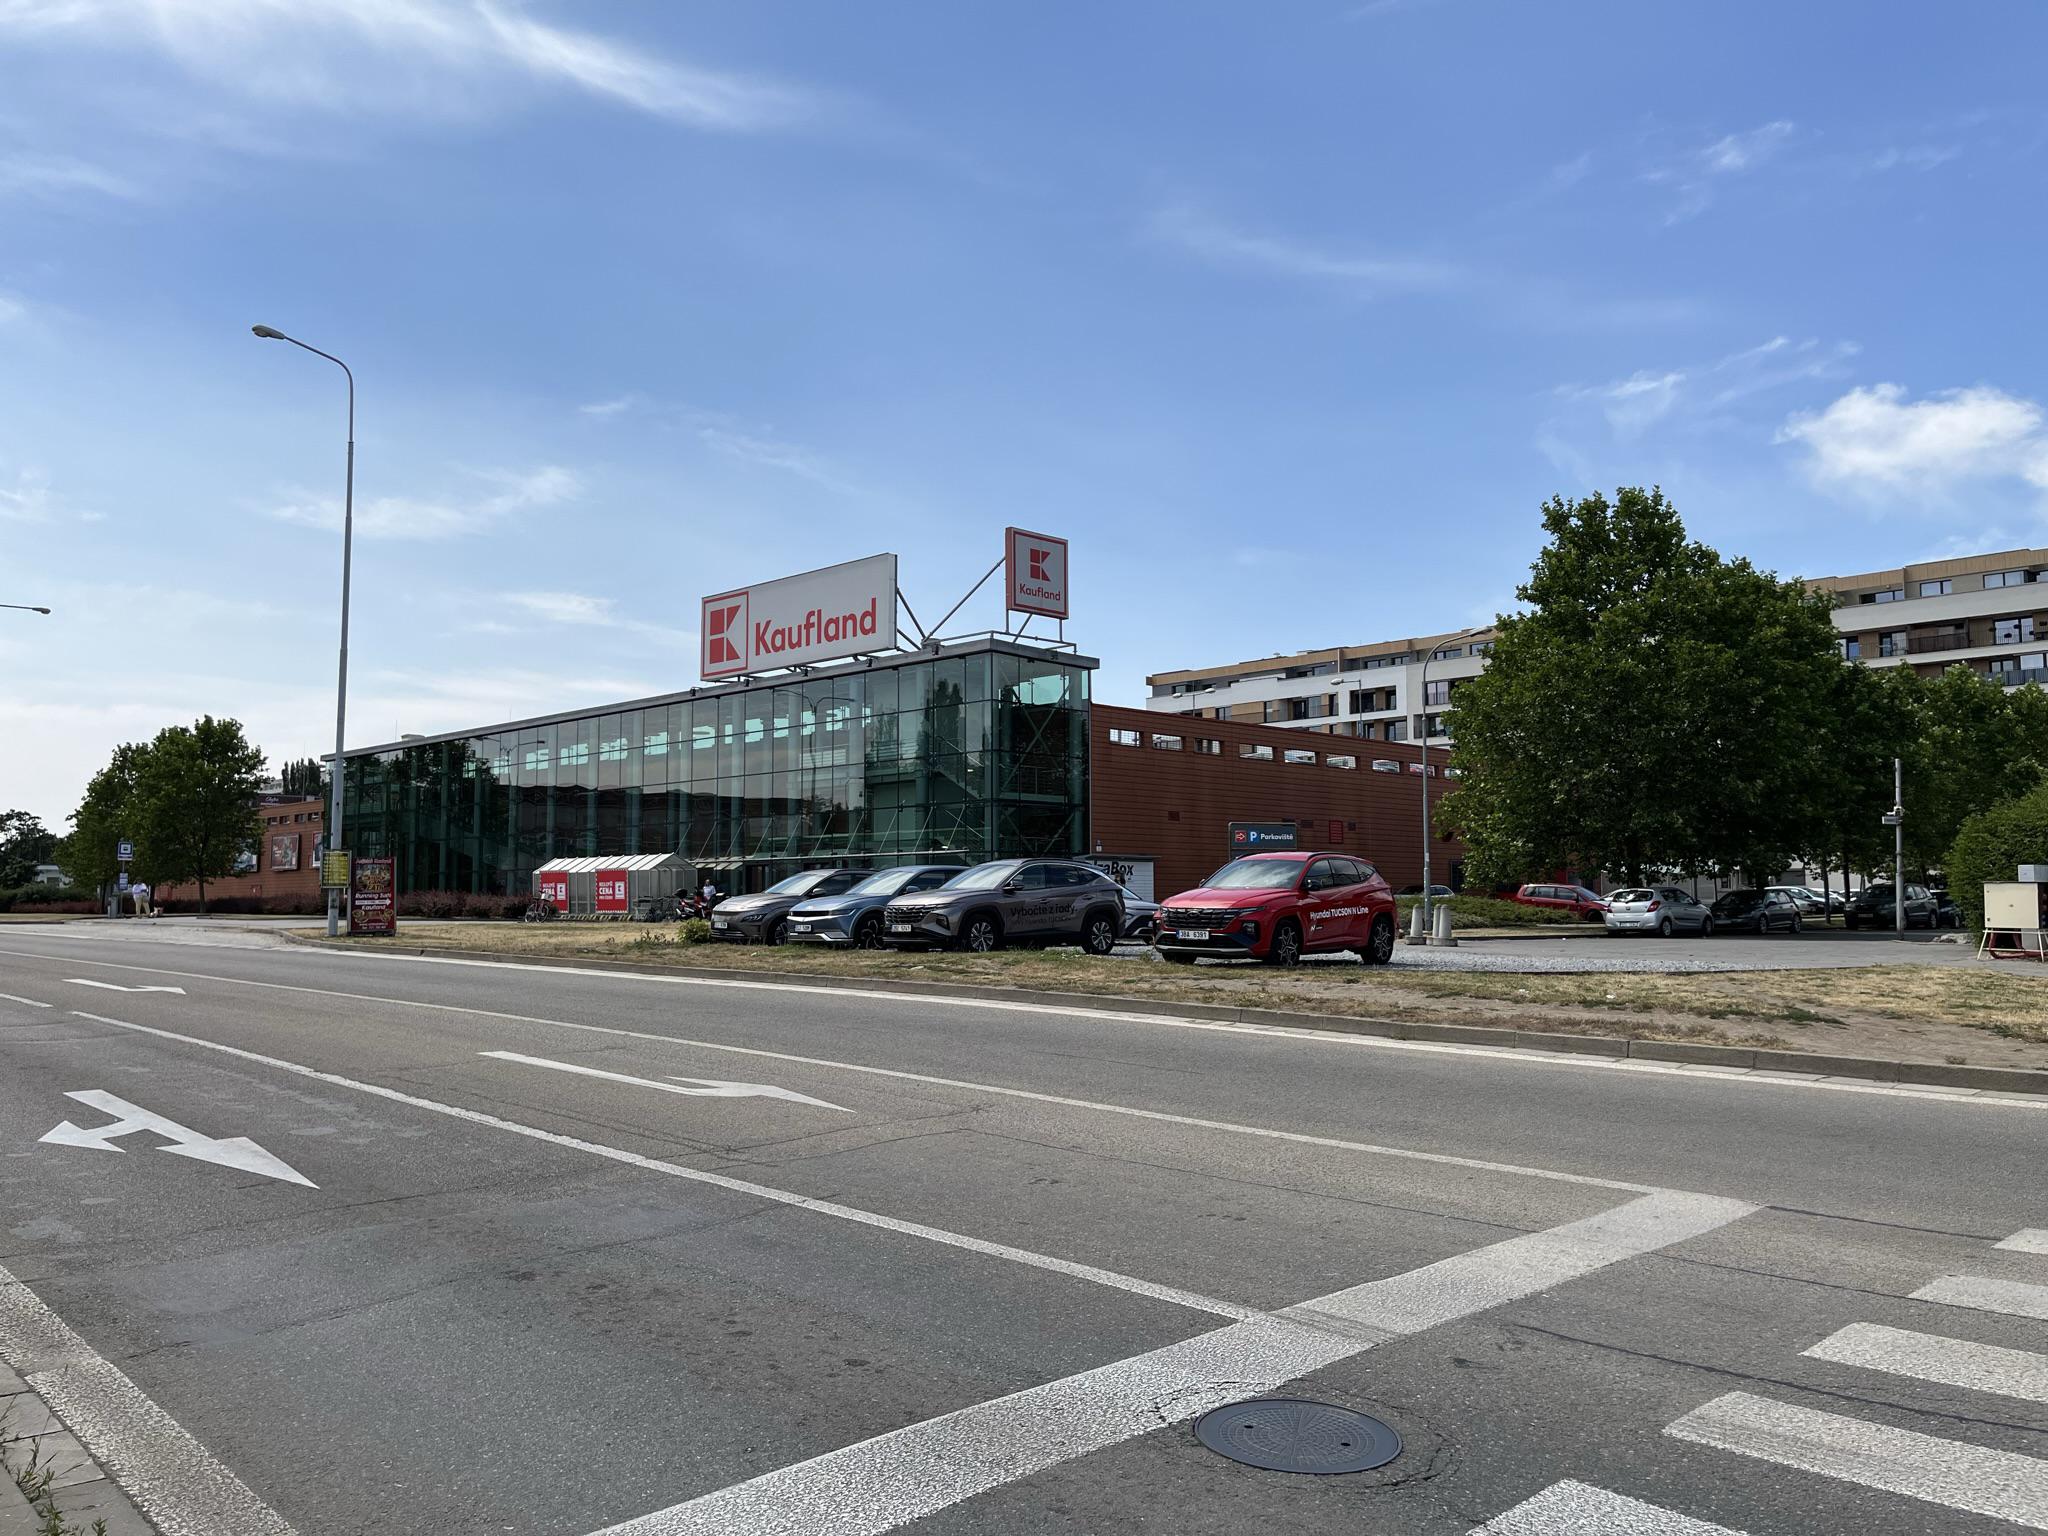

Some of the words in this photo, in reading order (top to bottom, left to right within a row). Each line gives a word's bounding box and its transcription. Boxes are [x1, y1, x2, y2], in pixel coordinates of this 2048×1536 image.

[1019, 583, 1061, 601] Kaufland
[755, 597, 877, 657] Kaufland
[1310, 909, 1331, 920] Hyundai
[1331, 907, 1352, 917] TUCSON
[1357, 905, 1369, 914] Line
